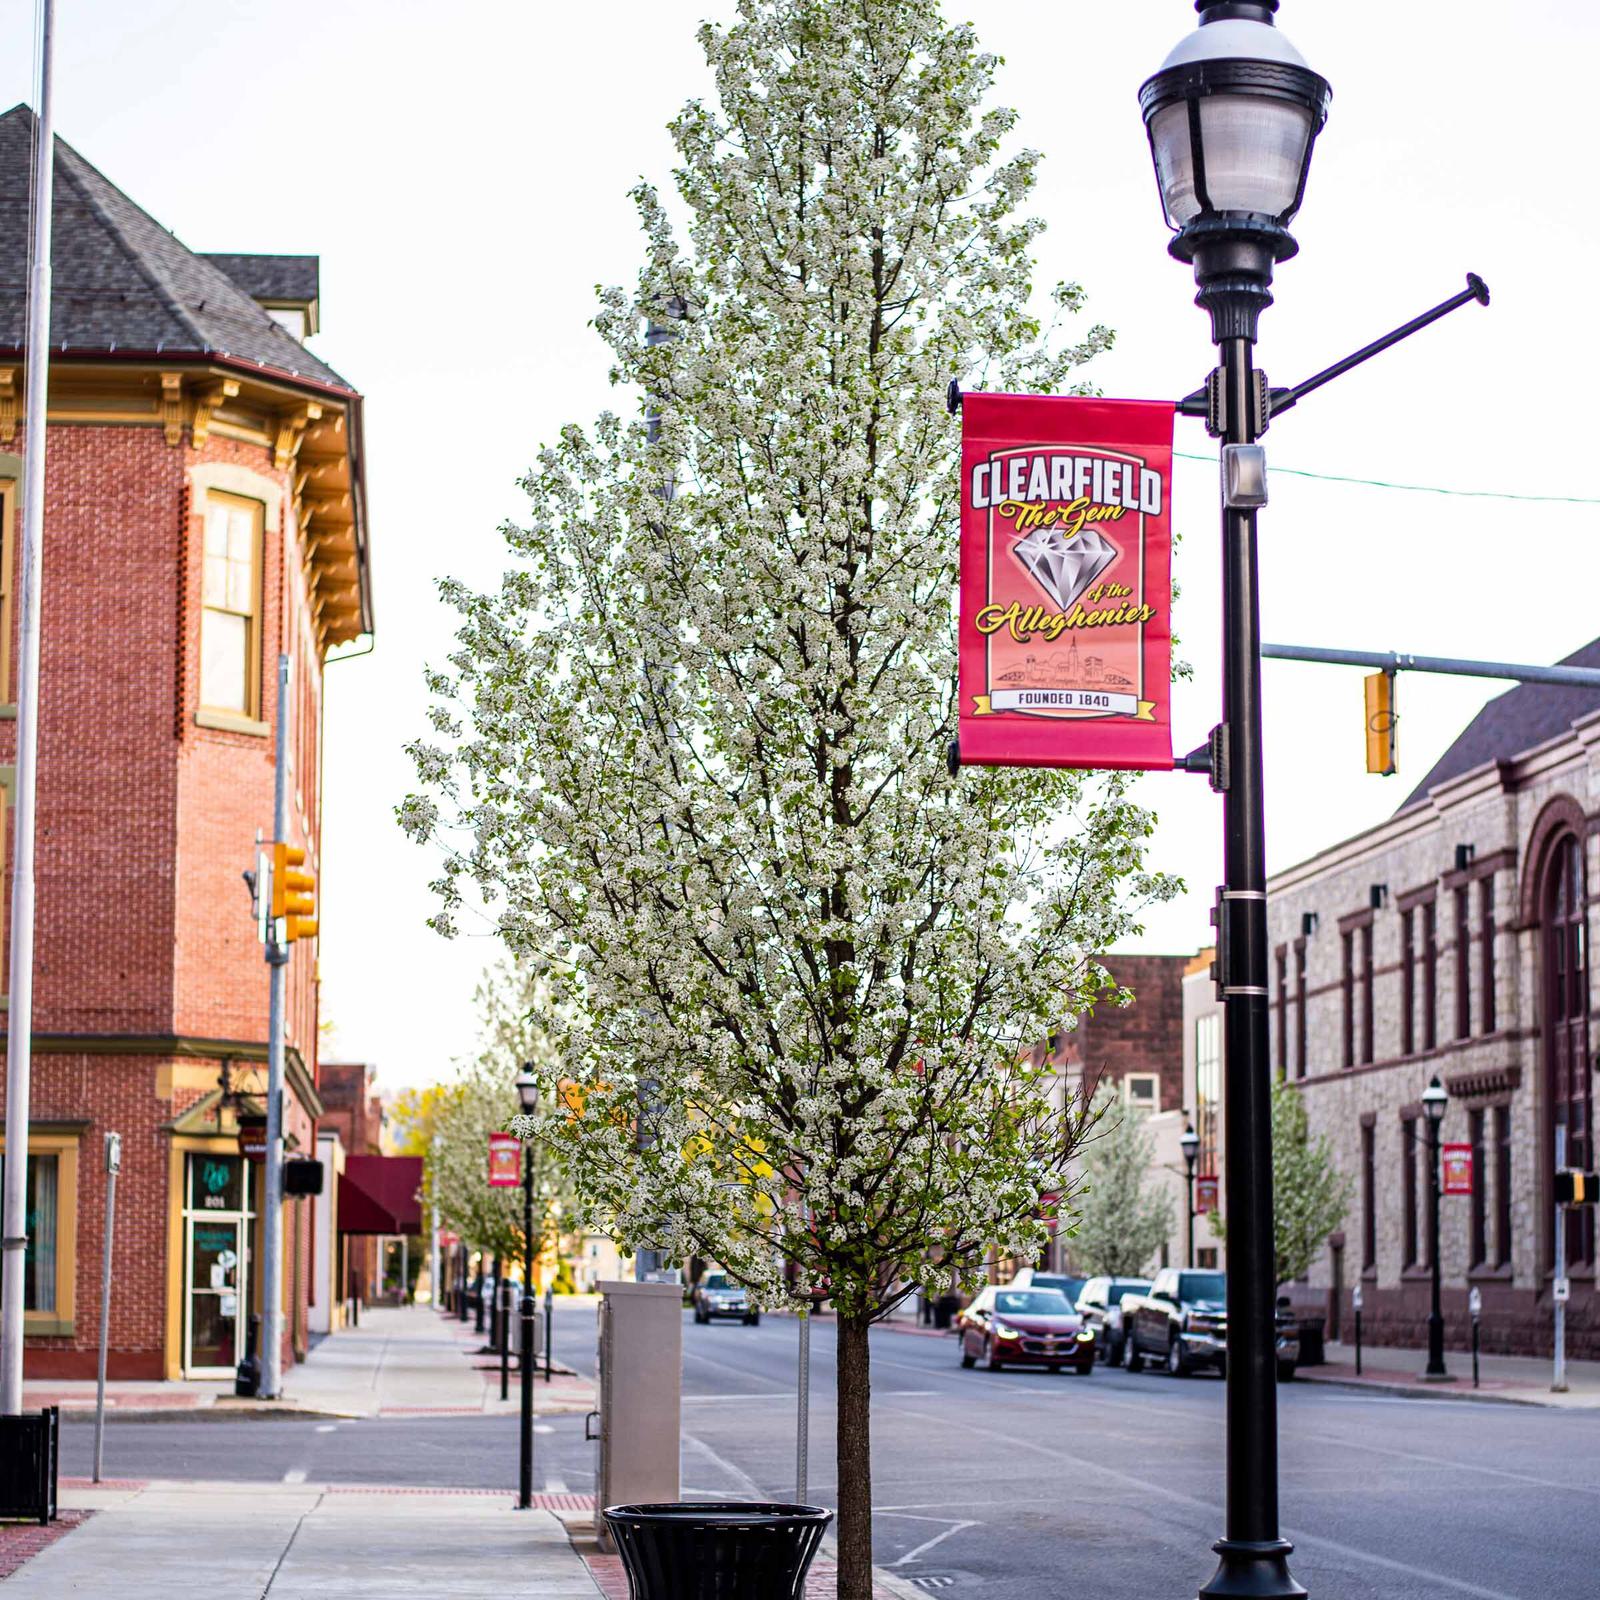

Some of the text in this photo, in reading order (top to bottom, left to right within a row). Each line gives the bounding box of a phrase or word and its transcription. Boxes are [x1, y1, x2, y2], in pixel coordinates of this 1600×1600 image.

[972, 456, 1162, 516] CLEARFIELD
[998, 496, 1126, 538] The Gem
[1087, 582, 1132, 603] of the
[975, 601, 1156, 643] Alleghenies
[1018, 693, 1109, 708] FOUNDED 1840
